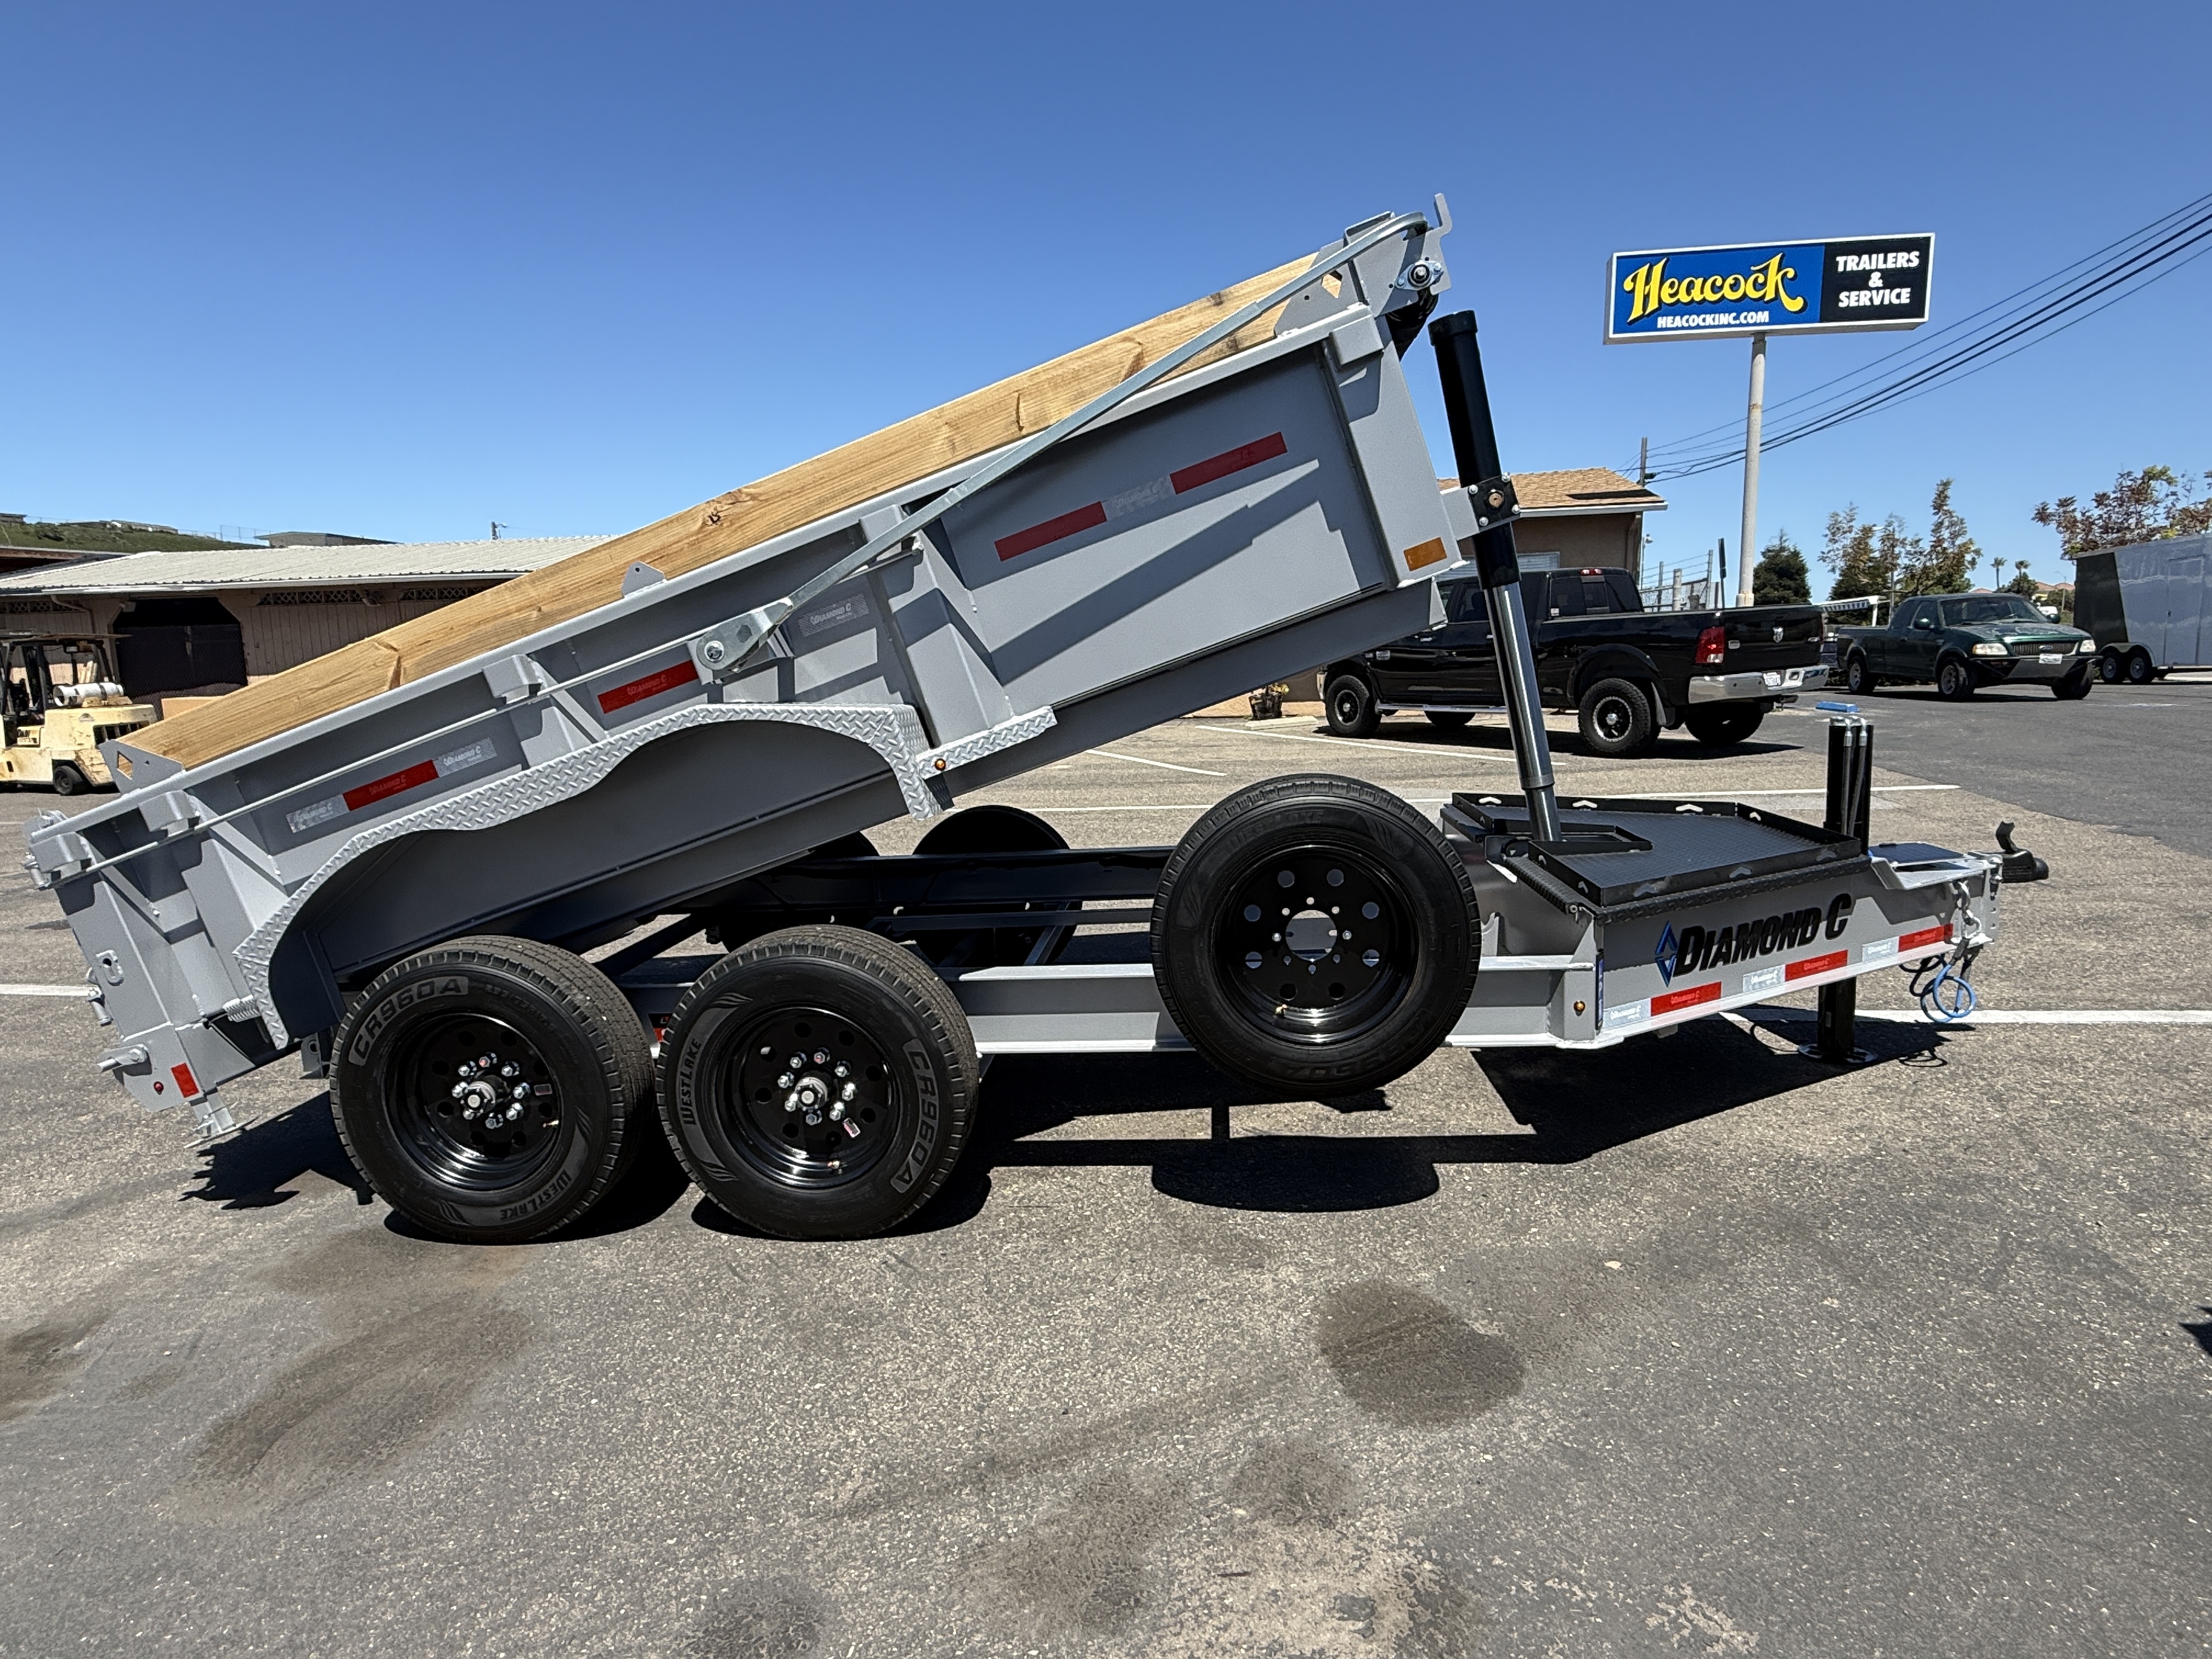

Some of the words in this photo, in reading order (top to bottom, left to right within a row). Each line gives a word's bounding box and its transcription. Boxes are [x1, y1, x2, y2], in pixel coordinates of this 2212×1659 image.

[1623, 252, 1805, 324] Heacock
[1836, 251, 1920, 273] TRAILERS
[1868, 273, 1883, 287] &
[1657, 311, 1770, 329] HEACOCKINC.COM
[1838, 288, 1911, 308] SERVICE
[1673, 907, 1822, 978] DIAMOND
[1825, 893, 1853, 940] C
[352, 977, 462, 1059] CR960A
[678, 1038, 700, 1126] WESTLAKE
[894, 1050, 938, 1187] CR960A
[499, 1169, 573, 1220] WESTLAKE
